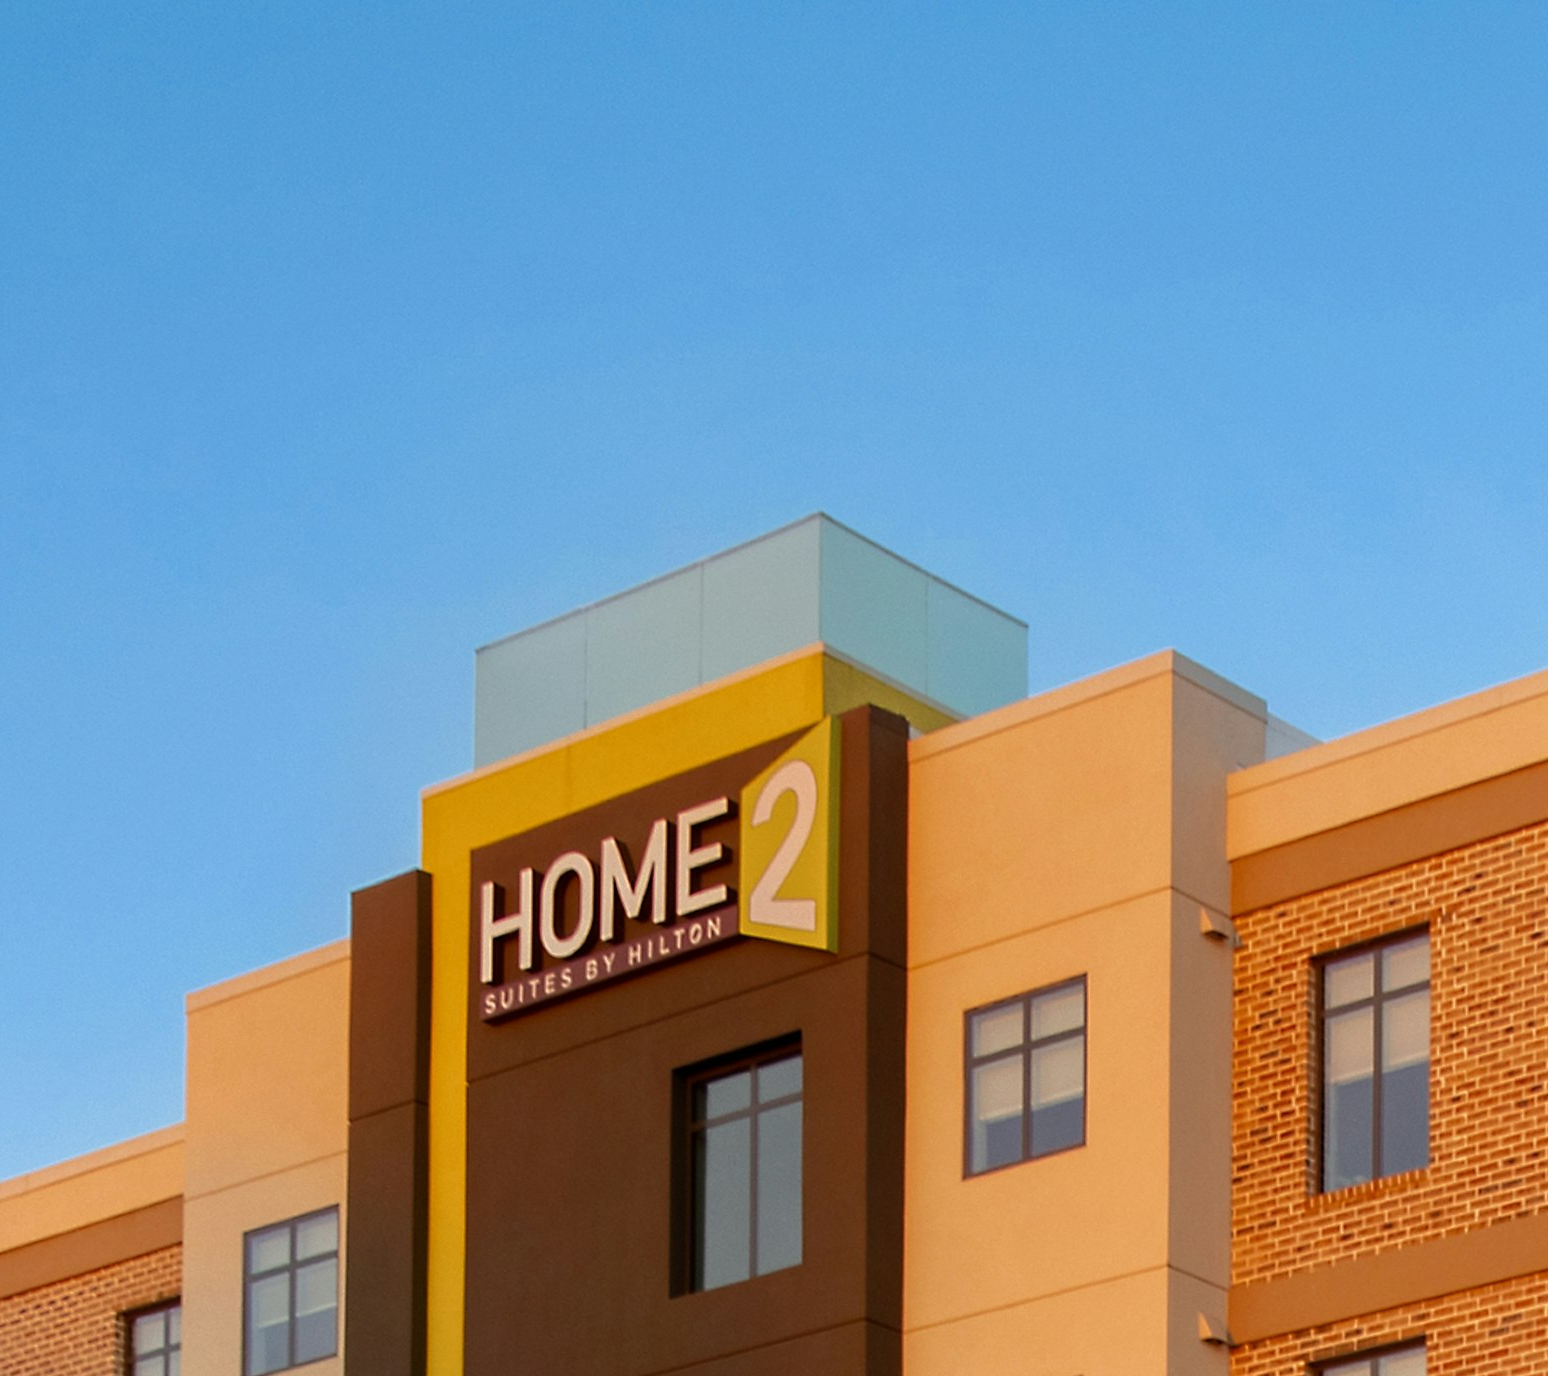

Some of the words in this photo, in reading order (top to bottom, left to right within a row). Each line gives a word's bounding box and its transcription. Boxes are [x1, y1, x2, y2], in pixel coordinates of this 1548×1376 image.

[480, 796, 729, 984] HOME
[749, 758, 818, 932] 2
[484, 968, 573, 1015] SUITES
[586, 953, 616, 981] BY
[627, 916, 722, 967] HILTON
